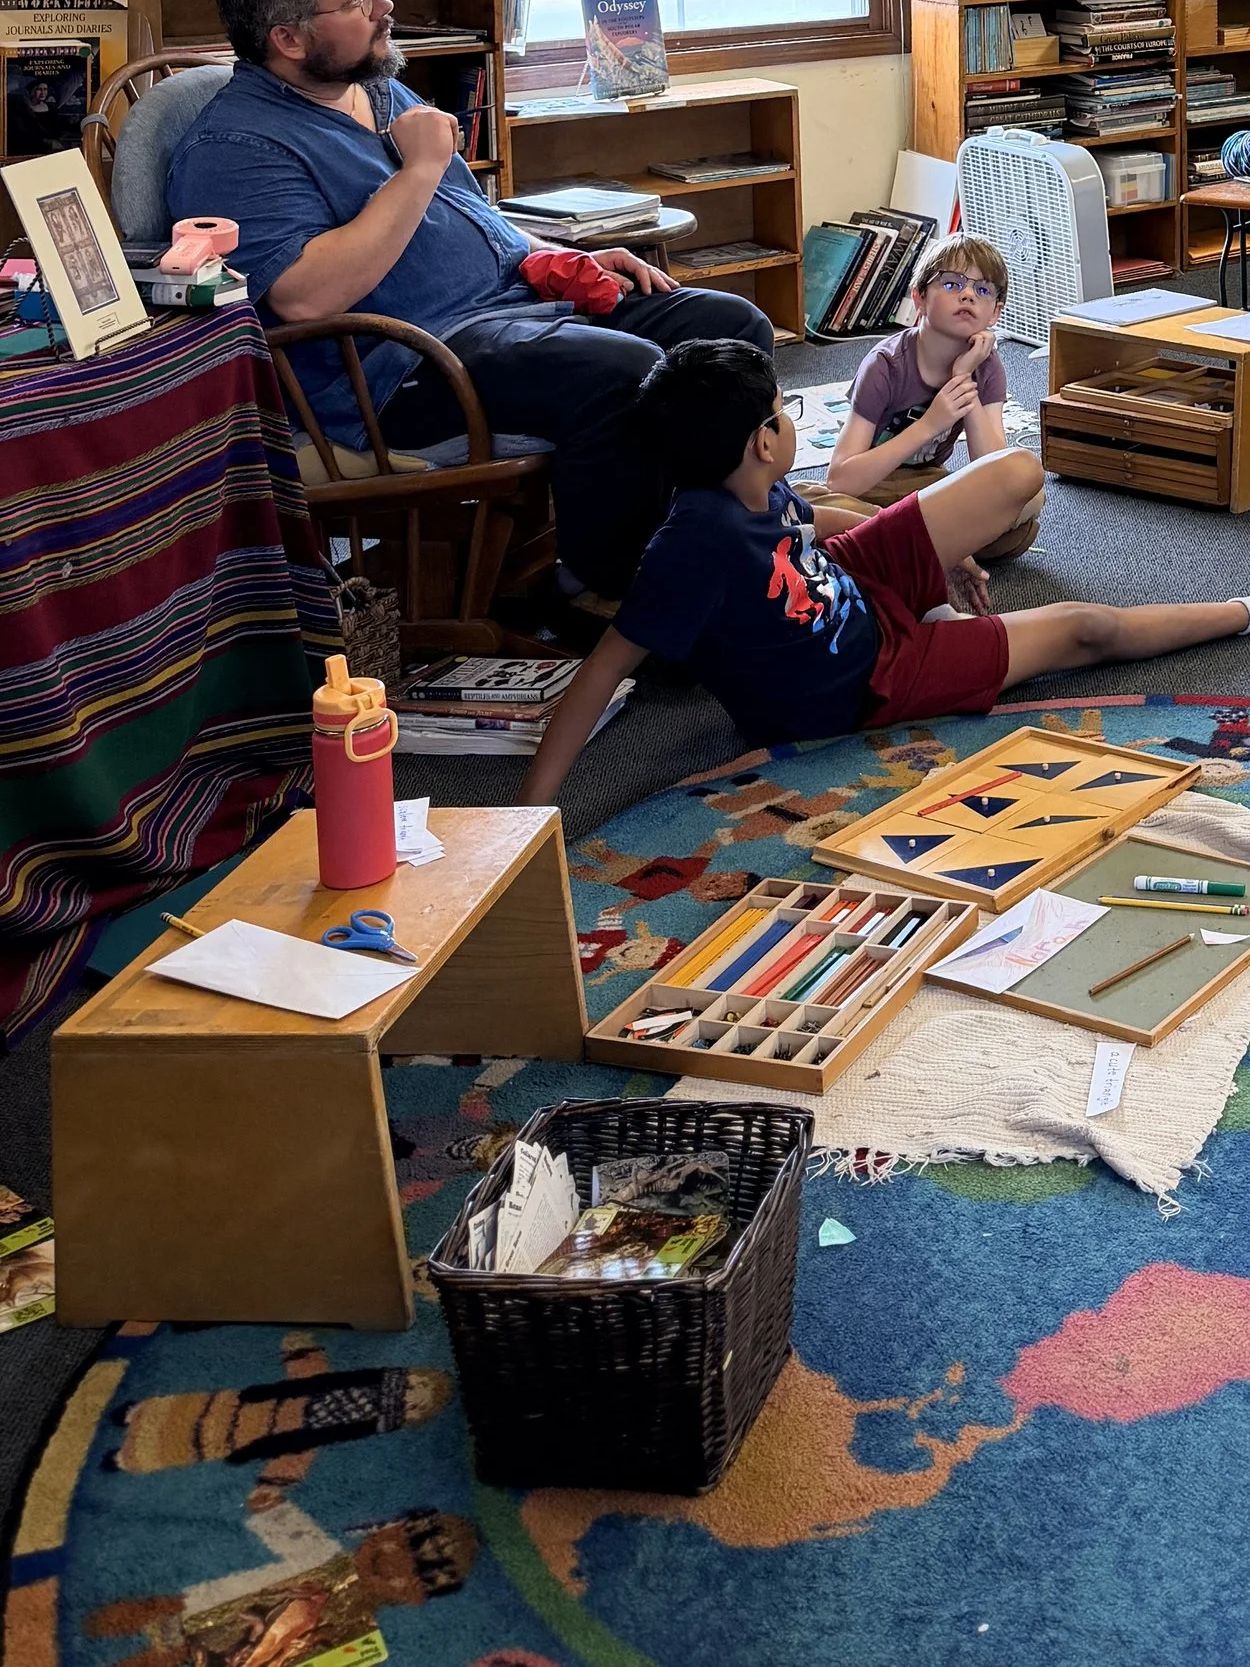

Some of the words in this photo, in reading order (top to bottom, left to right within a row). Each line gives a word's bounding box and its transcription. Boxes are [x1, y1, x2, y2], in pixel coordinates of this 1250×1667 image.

[597, 0, 647, 15] Odyssey
[33, 13, 86, 23] EXPLORING
[6, 25, 53, 36] JOURNALS
[54, 25, 75, 34] AND
[76, 24, 113, 34] DIARIES
[1101, 45, 1114, 53] THE
[1113, 43, 1140, 52] COURTS
[1145, 39, 1168, 48] EUROPE
[989, 103, 1018, 111] MIDDLE
[1021, 101, 1039, 109] AGES
[989, 114, 1015, 124] GREAT
[1015, 109, 1061, 122] CATHEDRALS
[881, 238, 908, 276] WAR
[463, 692, 491, 700] REPTILES
[501, 692, 539, 701] AMPHIBIANS
[1107, 1051, 1121, 1076] acute
